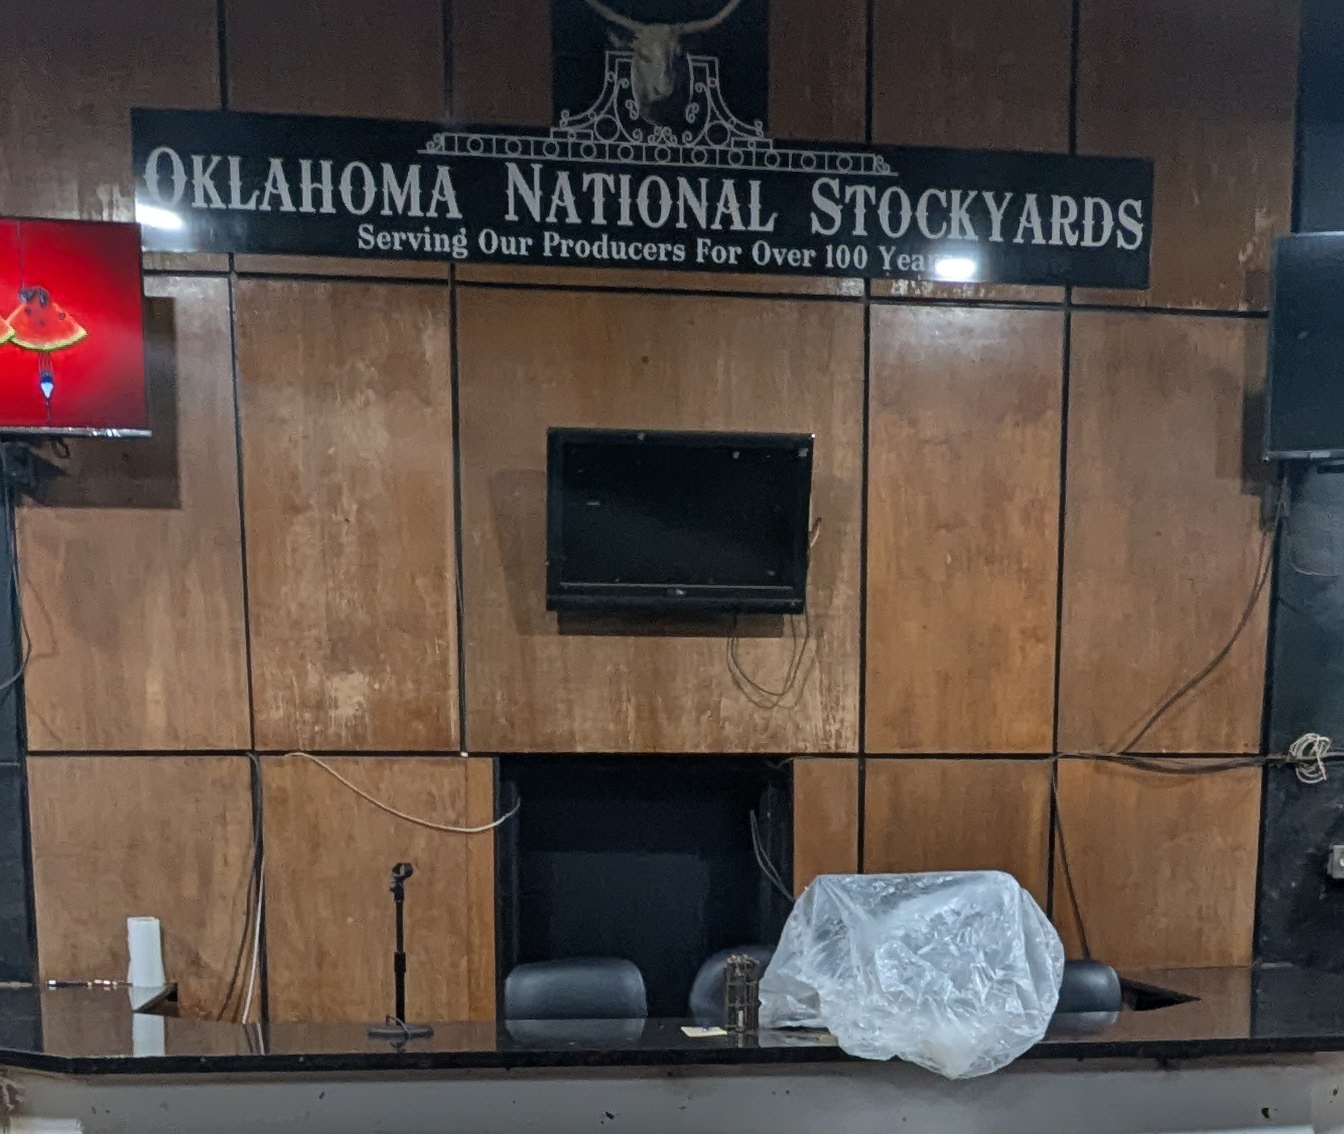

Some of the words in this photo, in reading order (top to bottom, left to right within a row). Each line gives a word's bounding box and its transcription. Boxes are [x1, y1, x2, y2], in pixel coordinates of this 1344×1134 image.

[143, 146, 462, 220] OKLAHOMA
[504, 161, 777, 232] NATIONAL
[810, 177, 1145, 251] STOCKYARDS
[358, 224, 467, 259] Serving
[478, 229, 533, 256] Our
[542, 232, 686, 263] Producers
[696, 238, 741, 265] For
[752, 241, 816, 268] Over
[825, 244, 868, 270] 100
[879, 245, 955, 274] Year
